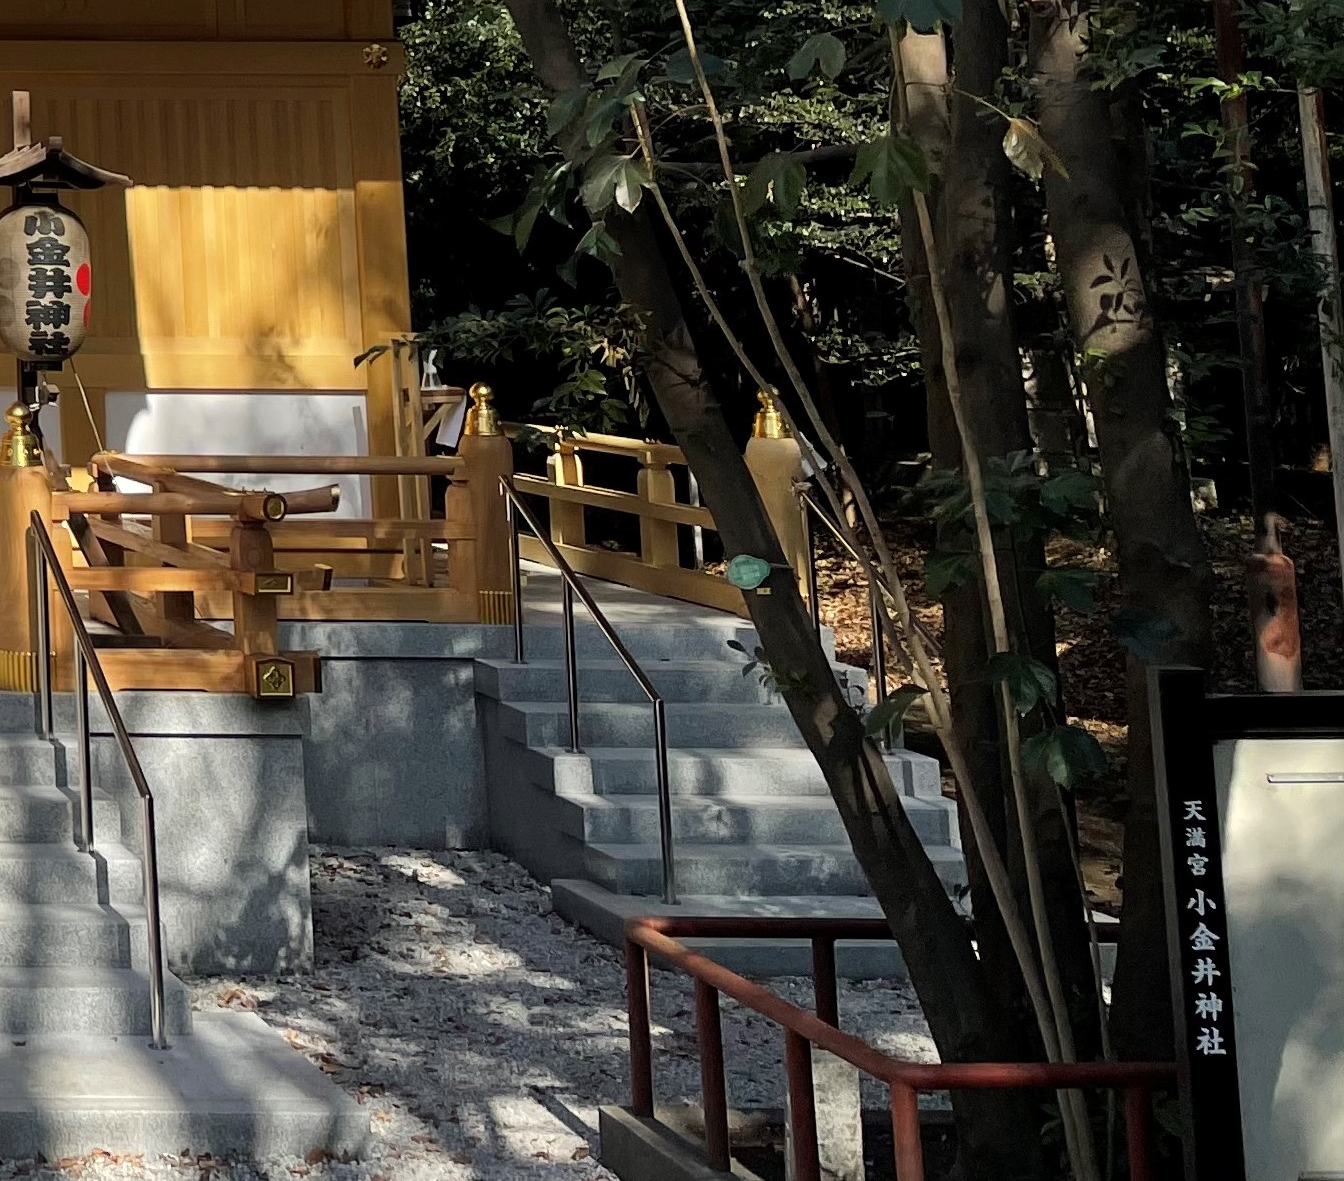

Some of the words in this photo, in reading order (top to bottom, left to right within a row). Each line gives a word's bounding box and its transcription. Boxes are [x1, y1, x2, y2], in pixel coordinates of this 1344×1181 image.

[24, 211, 72, 355] 小金井神社
[1186, 888, 1227, 1056] 小金井神社
